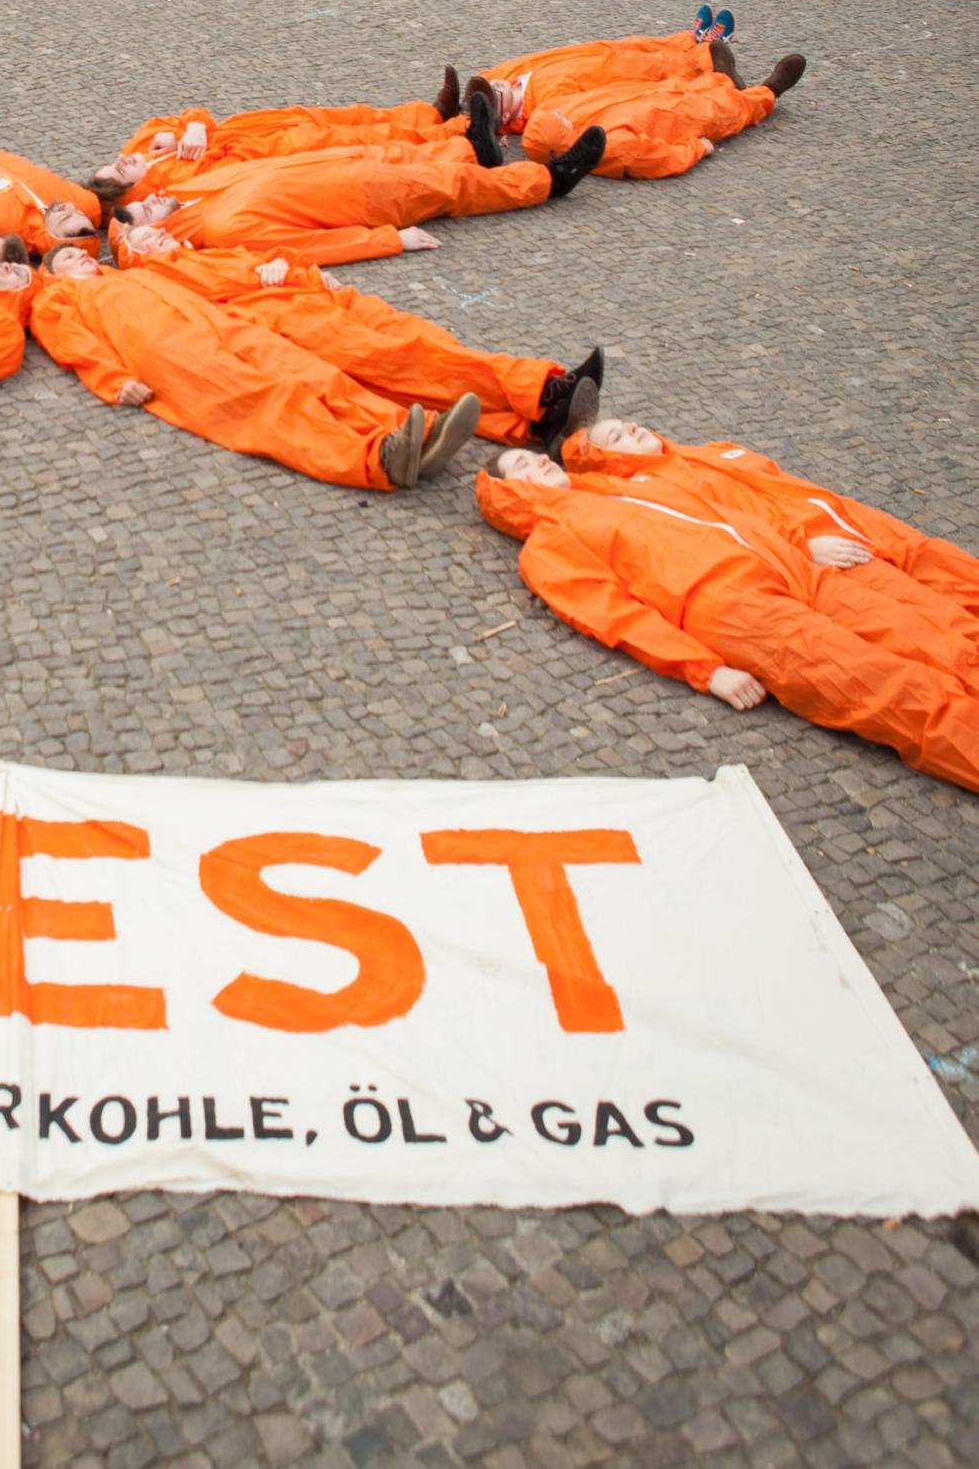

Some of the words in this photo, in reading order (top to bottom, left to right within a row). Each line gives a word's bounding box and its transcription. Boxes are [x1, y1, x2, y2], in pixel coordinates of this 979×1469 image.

[39, 1094, 318, 1146] KOHLE,
[343, 1085, 447, 1144] ÖL
[466, 1099, 512, 1144] &
[531, 1100, 696, 1148] GAS
